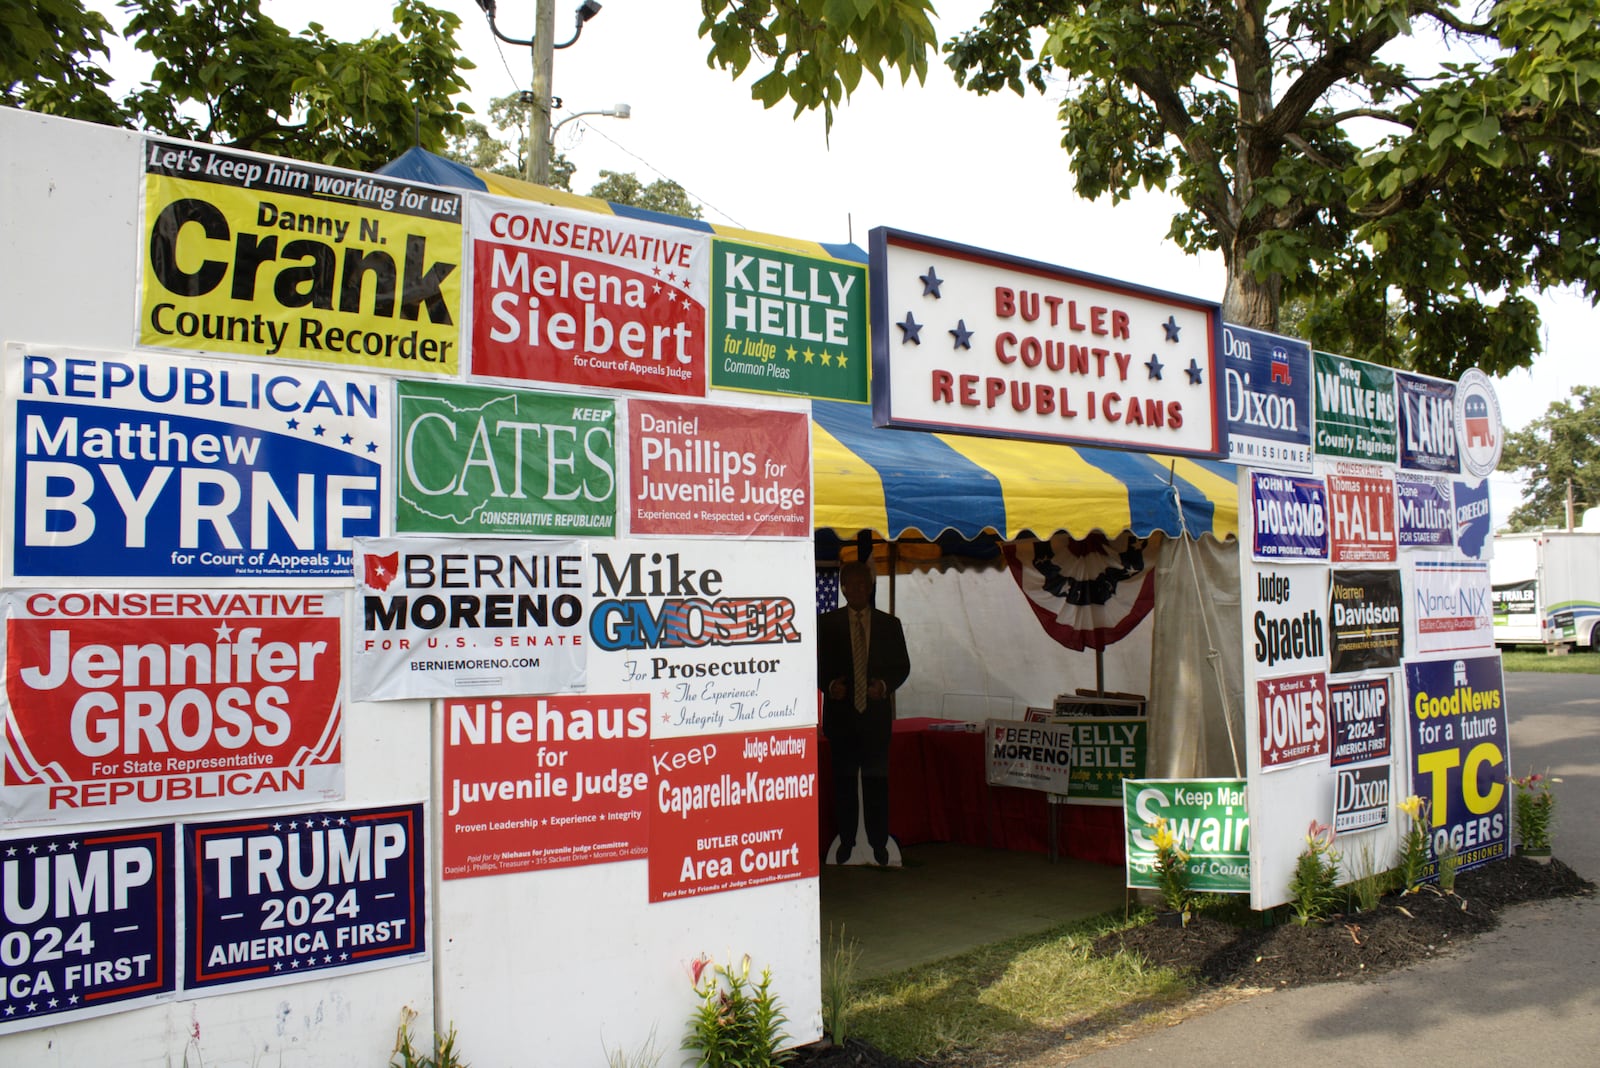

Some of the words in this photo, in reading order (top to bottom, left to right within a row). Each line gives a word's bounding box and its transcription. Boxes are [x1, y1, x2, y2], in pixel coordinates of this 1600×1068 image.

[149, 145, 202, 171] Let's
[205, 154, 261, 188] keep
[267, 164, 309, 190] him
[313, 174, 396, 209] working
[400, 187, 427, 209] for
[431, 195, 458, 215] us!
[257, 201, 349, 243] Danny
[359, 217, 387, 245] N.
[489, 212, 692, 268] CONSERVATIVE
[150, 198, 457, 326] Crank
[491, 249, 646, 309] Melena
[725, 252, 856, 307] KELLY
[489, 291, 692, 364] Siebert
[725, 292, 849, 346] HEILE
[995, 286, 1130, 341] BUTLER
[151, 303, 288, 355] County
[299, 317, 453, 363] Recorder
[724, 334, 740, 355] for
[743, 337, 776, 362] Judge
[1223, 328, 1252, 361] Don
[573, 355, 588, 367] for
[589, 356, 617, 370] Court
[618, 359, 628, 371] of
[629, 360, 664, 377] Appeals
[665, 363, 692, 381] Judge
[724, 357, 765, 377] Common
[767, 362, 791, 379] Pleas
[995, 331, 1132, 382] COUNTY
[1339, 362, 1361, 386] Greg
[23, 355, 378, 419] REPUBLICAN
[932, 369, 1184, 430] REPUBLICANS
[1225, 368, 1298, 432] Dixon
[1317, 371, 1395, 423] WILKENS
[572, 407, 611, 422] KEEP
[640, 413, 698, 435] Daniel
[1403, 392, 1456, 456] LANG
[26, 414, 261, 465] Matthew
[404, 412, 616, 502] CATES
[1229, 441, 1312, 463] OMMISSIONER
[1317, 430, 1354, 453] County
[1356, 434, 1395, 456] Engineer
[641, 438, 757, 483] Phillips
[764, 458, 787, 478] for
[638, 479, 735, 505] Juvenile
[740, 481, 805, 510] Judge
[1258, 477, 1283, 492] JOHN
[1283, 479, 1295, 492] M.
[1331, 476, 1360, 492] Thomas
[1398, 484, 1418, 496] Diane
[25, 460, 378, 550] BYRNE
[480, 512, 553, 527] CONSERVATIVE
[554, 513, 612, 528] REPUBLICAN
[638, 509, 690, 522] Experienced
[700, 510, 744, 523] Respected
[753, 512, 805, 524] Conservative
[1257, 498, 1324, 537] HOLCOMB
[1332, 493, 1393, 541] HALL
[1399, 499, 1453, 529] Mullins
[1457, 498, 1489, 523] CREECH
[171, 551, 195, 565] for
[200, 552, 245, 566] Court
[248, 551, 265, 566] of
[268, 552, 330, 569] Appeals
[405, 554, 583, 589] BERNIE
[592, 553, 723, 597] Mike
[26, 593, 324, 617] CONSERVATIVE
[1257, 572, 1290, 605] Judge
[1333, 585, 1364, 600] Warren
[1417, 588, 1456, 617] Nancy
[1459, 588, 1487, 616] NIX
[364, 594, 583, 631] MORENO
[589, 597, 802, 652] GMOSER
[1334, 602, 1399, 627] Davidson
[20, 622, 328, 690] Jennifer
[365, 639, 410, 651] FOR
[427, 636, 476, 649] U.S.
[494, 635, 583, 647] SENATE
[1255, 609, 1323, 667] Spaeth
[411, 658, 540, 671] BERNIEMORENO.COM
[622, 660, 646, 681] For
[651, 657, 780, 680] Prosecutor
[674, 683, 697, 702] The
[701, 679, 761, 705] Experience!
[1332, 688, 1386, 723] TRUMP
[70, 686, 291, 757] GROSS
[450, 700, 647, 746] Niehaus
[673, 710, 723, 729] Integrity
[729, 703, 754, 722] That
[758, 698, 797, 719] Counts!
[1263, 689, 1325, 752] JONES
[1347, 721, 1375, 740] 2024
[1419, 721, 1441, 744] for
[1444, 723, 1454, 741] a
[1461, 715, 1497, 740] future
[1006, 727, 1070, 748] BERNIE
[1071, 725, 1140, 746] ELLY
[1282, 745, 1311, 760] SHERIFF
[1336, 742, 1367, 757] AMERICA
[1368, 738, 1387, 751] FIRST
[92, 761, 118, 776] For
[125, 758, 162, 774] State
[166, 752, 274, 773] Representative
[537, 747, 568, 767] for
[652, 742, 717, 776] Keep
[743, 737, 769, 763] Judge
[770, 735, 806, 759] Courtney
[994, 744, 1069, 766] MORENO
[49, 770, 304, 810] REPUBLICAN
[448, 772, 568, 816] Juvenile
[572, 768, 648, 802] Judge
[658, 771, 816, 820] Caparella-Kraemer
[1175, 788, 1213, 810] Keep
[1217, 787, 1248, 806] Mar
[1340, 771, 1389, 812] Dixon
[1418, 742, 1504, 828] TC
[455, 822, 487, 833] Proven
[489, 818, 538, 832] Leadership
[550, 813, 597, 826] Experience
[608, 810, 642, 822] Integrity
[696, 834, 738, 851] BUTLER
[741, 828, 784, 845] COUNTY
[1427, 813, 1503, 859] OGERS
[205, 823, 407, 899] TRUMP
[680, 855, 733, 883] Area
[740, 842, 800, 873] Court
[1191, 862, 1206, 874] of
[3, 847, 153, 924] UMP
[260, 888, 360, 931] 2024
[0, 922, 95, 967] 024
[207, 930, 328, 967] AMERICA
[337, 918, 406, 949] FIRST
[65, 954, 151, 991] FIRST
